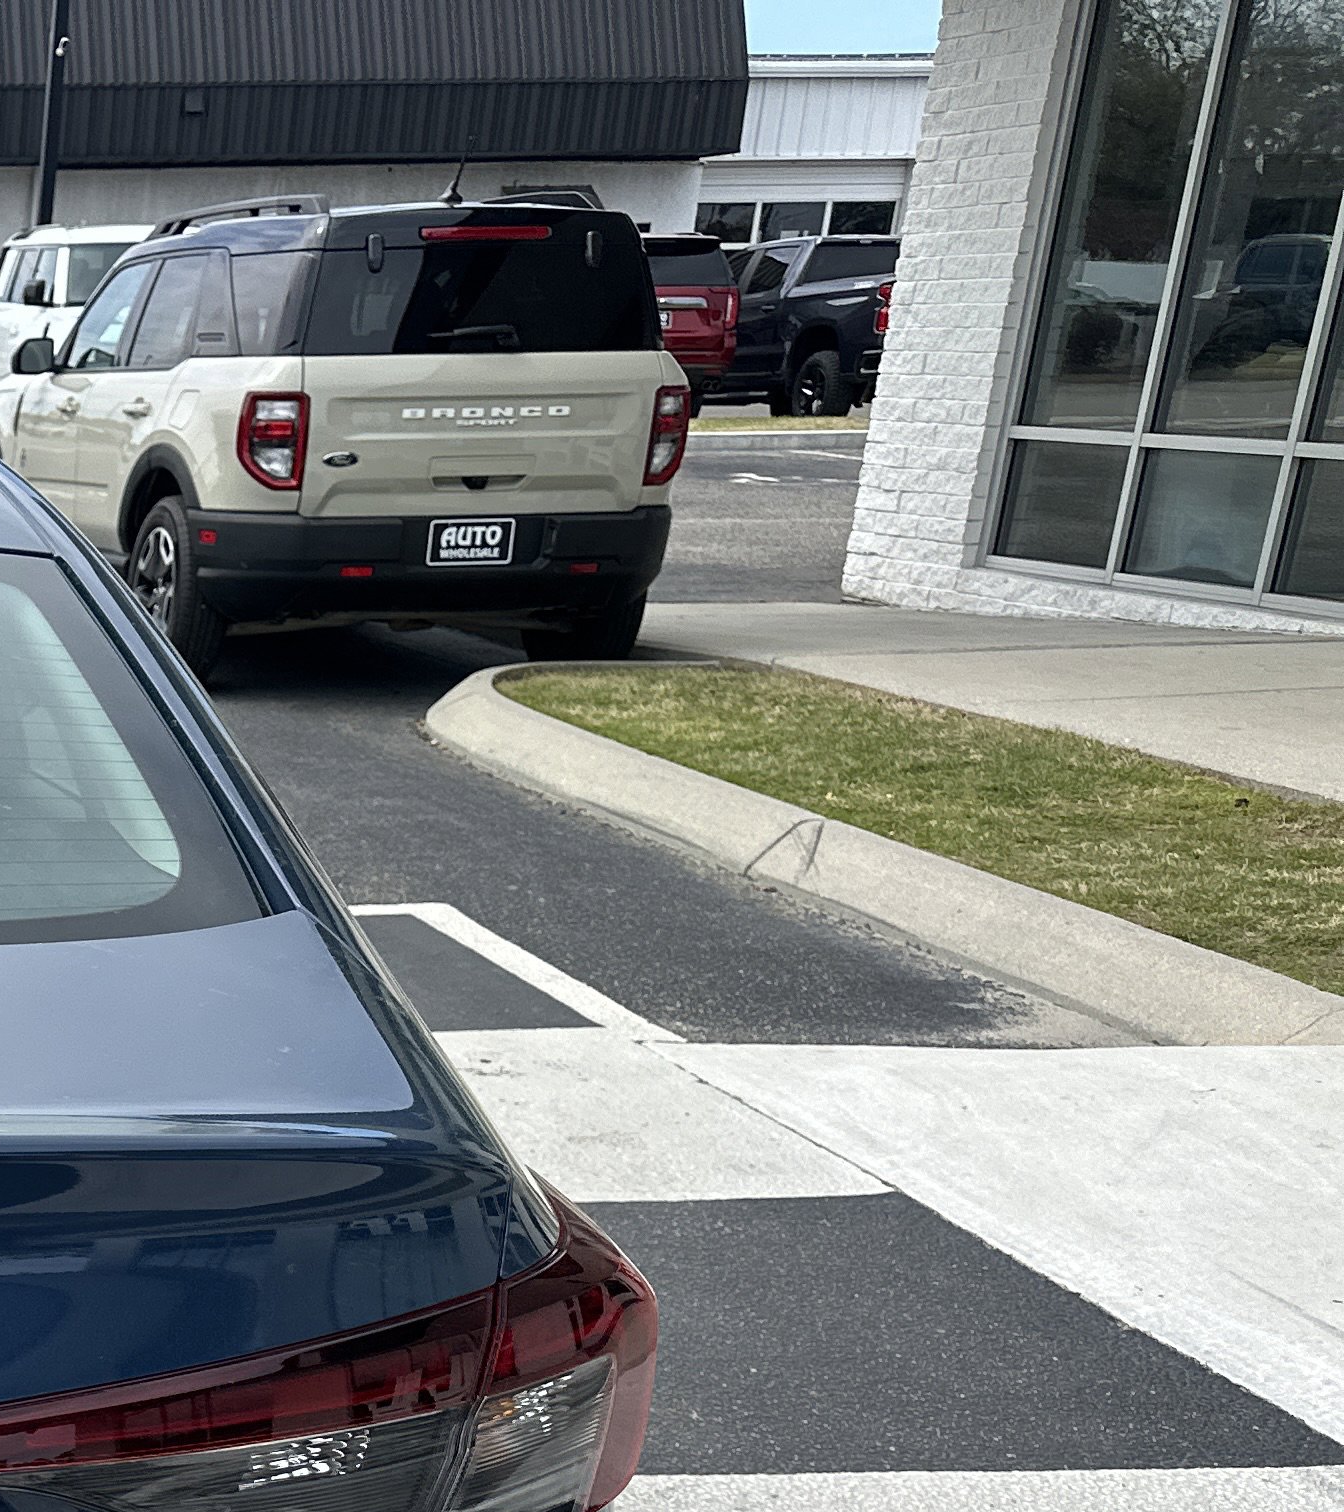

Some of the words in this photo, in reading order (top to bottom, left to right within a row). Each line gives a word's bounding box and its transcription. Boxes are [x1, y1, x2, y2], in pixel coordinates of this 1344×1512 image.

[401, 405, 571, 419] BRONCO
[455, 418, 518, 427] SPORT
[440, 525, 503, 548] AUTO
[439, 546, 500, 559] WHOLESALE
